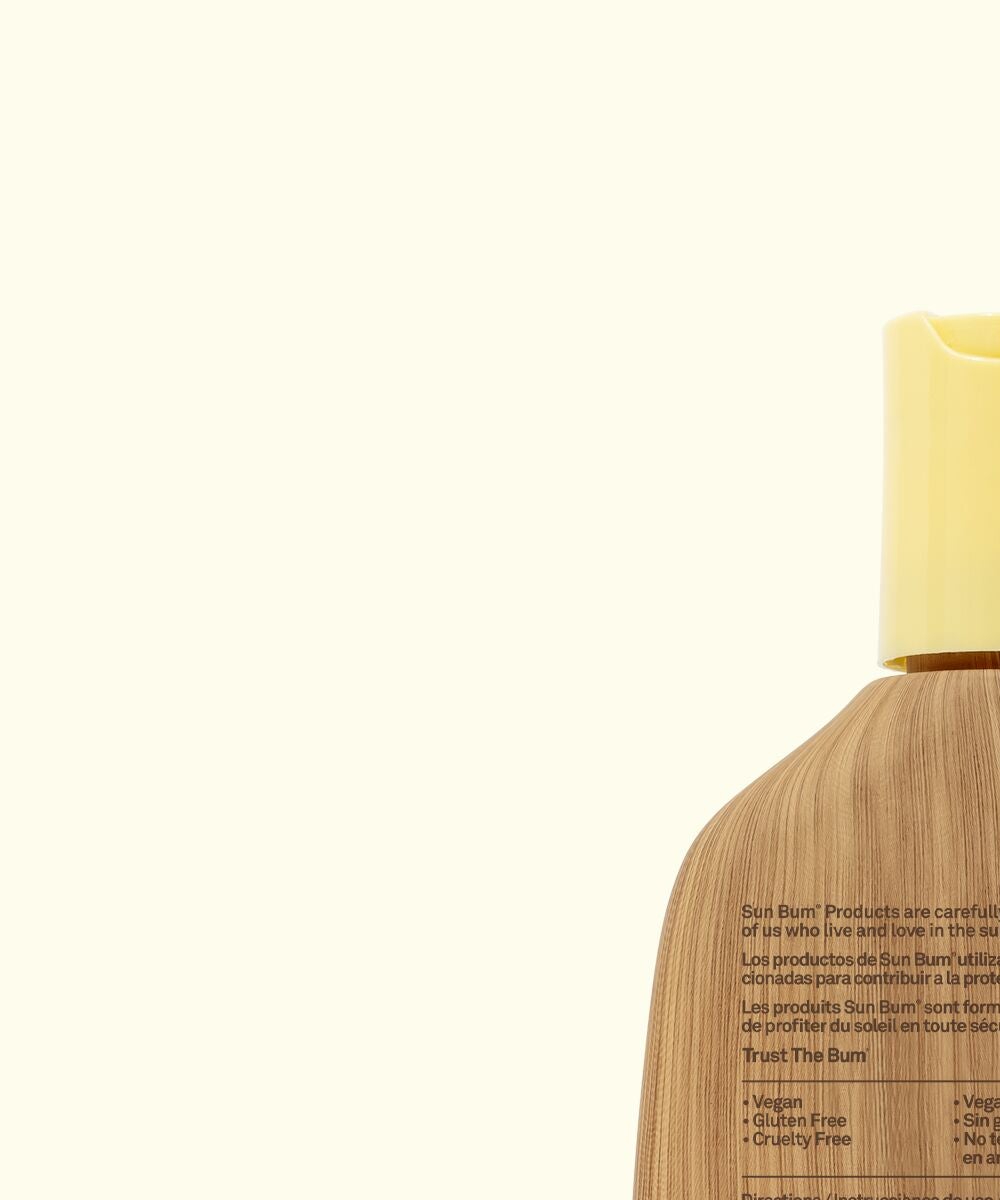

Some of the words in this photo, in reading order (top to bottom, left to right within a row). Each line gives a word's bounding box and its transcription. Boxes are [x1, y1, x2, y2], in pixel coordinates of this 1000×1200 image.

[741, 904, 773, 919] Sun
[825, 904, 900, 919] Products
[903, 907, 930, 919] are
[741, 922, 759, 937] of
[762, 926, 782, 937] us
[785, 922, 820, 937] who
[824, 922, 852, 937] live
[856, 922, 887, 937] and
[891, 922, 925, 937] love
[929, 922, 944, 937] in
[947, 922, 976, 937] the
[742, 951, 769, 966] Los
[773, 951, 854, 970] productos
[856, 951, 877, 966] de
[879, 951, 910, 966] Sun
[741, 970, 813, 985] cionadas
[816, 973, 851, 989] para
[854, 970, 932, 985] contribuir
[934, 973, 943, 985] a
[946, 970, 960, 985] la
[742, 999, 769, 1014] Les
[773, 999, 841, 1018] produits
[844, 999, 875, 1014] Sun
[924, 999, 960, 1014] sont
[741, 1017, 762, 1032] de
[765, 1017, 827, 1036] profiter
[830, 1017, 850, 1032] du
[854, 1017, 897, 1032] soleil
[901, 1021, 920, 1032] en
[923, 1017, 967, 1032] toute
[742, 1047, 788, 1062] Trust
[791, 1047, 824, 1062] The
[752, 1093, 802, 1112] Vegan
[752, 1112, 807, 1127] Gluten
[810, 1112, 847, 1127] Free
[963, 1112, 989, 1127] Sin
[752, 1130, 812, 1150] Cruelty
[815, 1130, 851, 1146] Free
[964, 1130, 986, 1146] No
[962, 1153, 983, 1164] en
